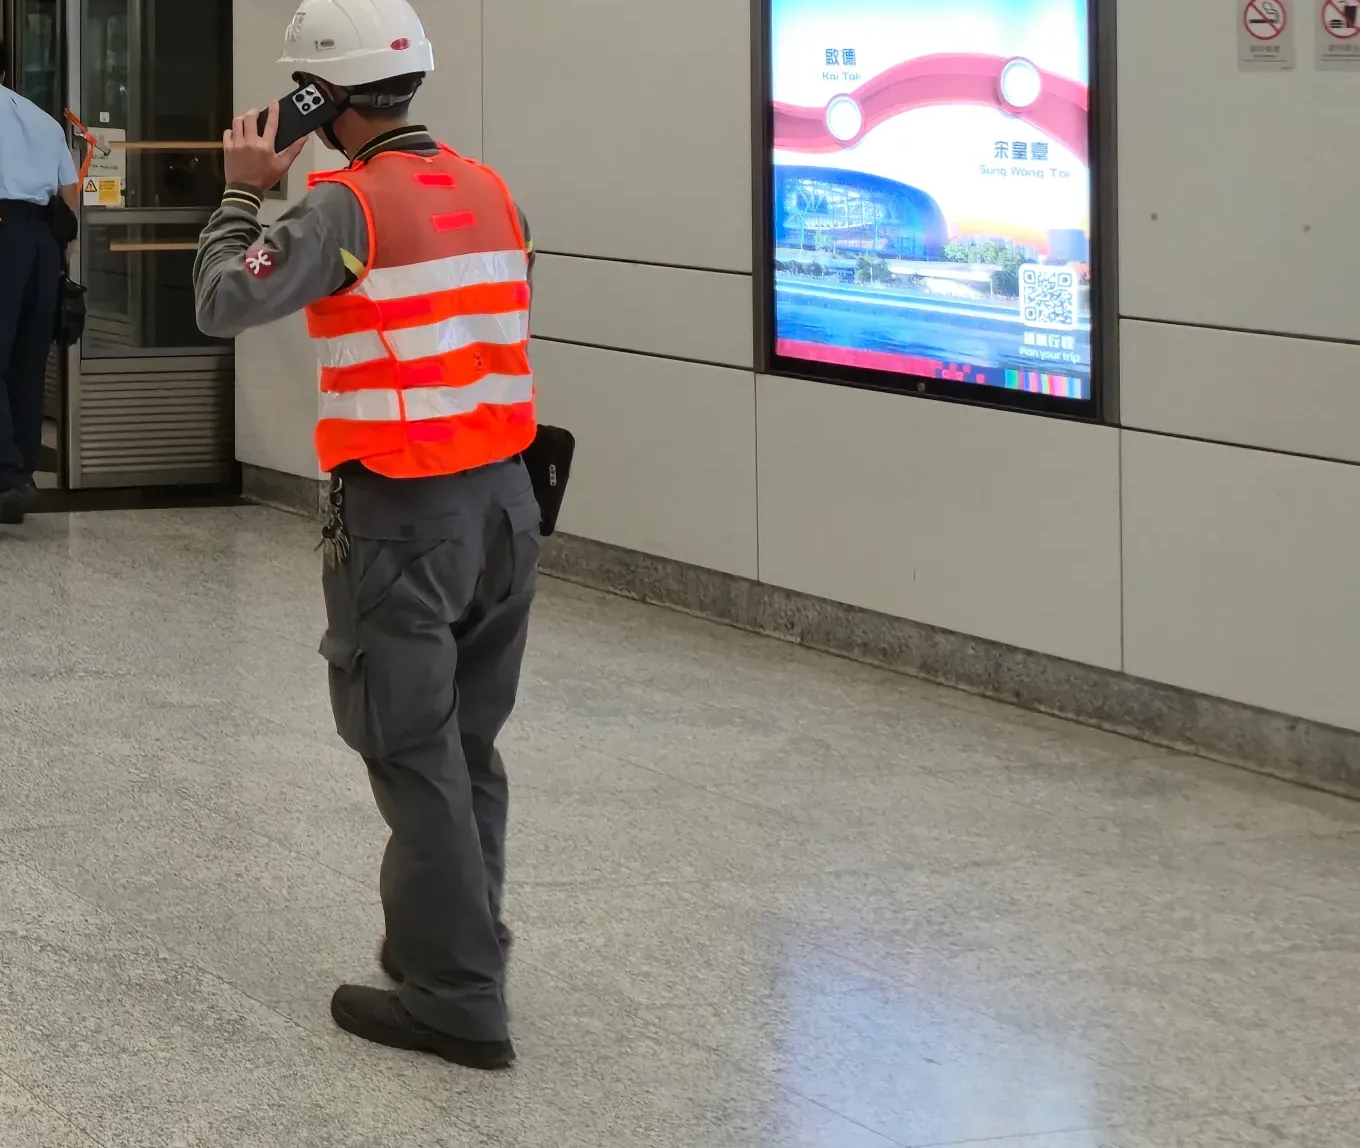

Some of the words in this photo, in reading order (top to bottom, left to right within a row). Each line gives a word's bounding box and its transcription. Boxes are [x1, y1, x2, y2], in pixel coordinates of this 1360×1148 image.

[824, 48, 857, 66] 啟德
[822, 71, 840, 81] Kai
[843, 71, 861, 81] Tak
[993, 140, 1049, 161] 宋皇臺
[979, 164, 1007, 177] Sung
[1010, 165, 1044, 179] Wong
